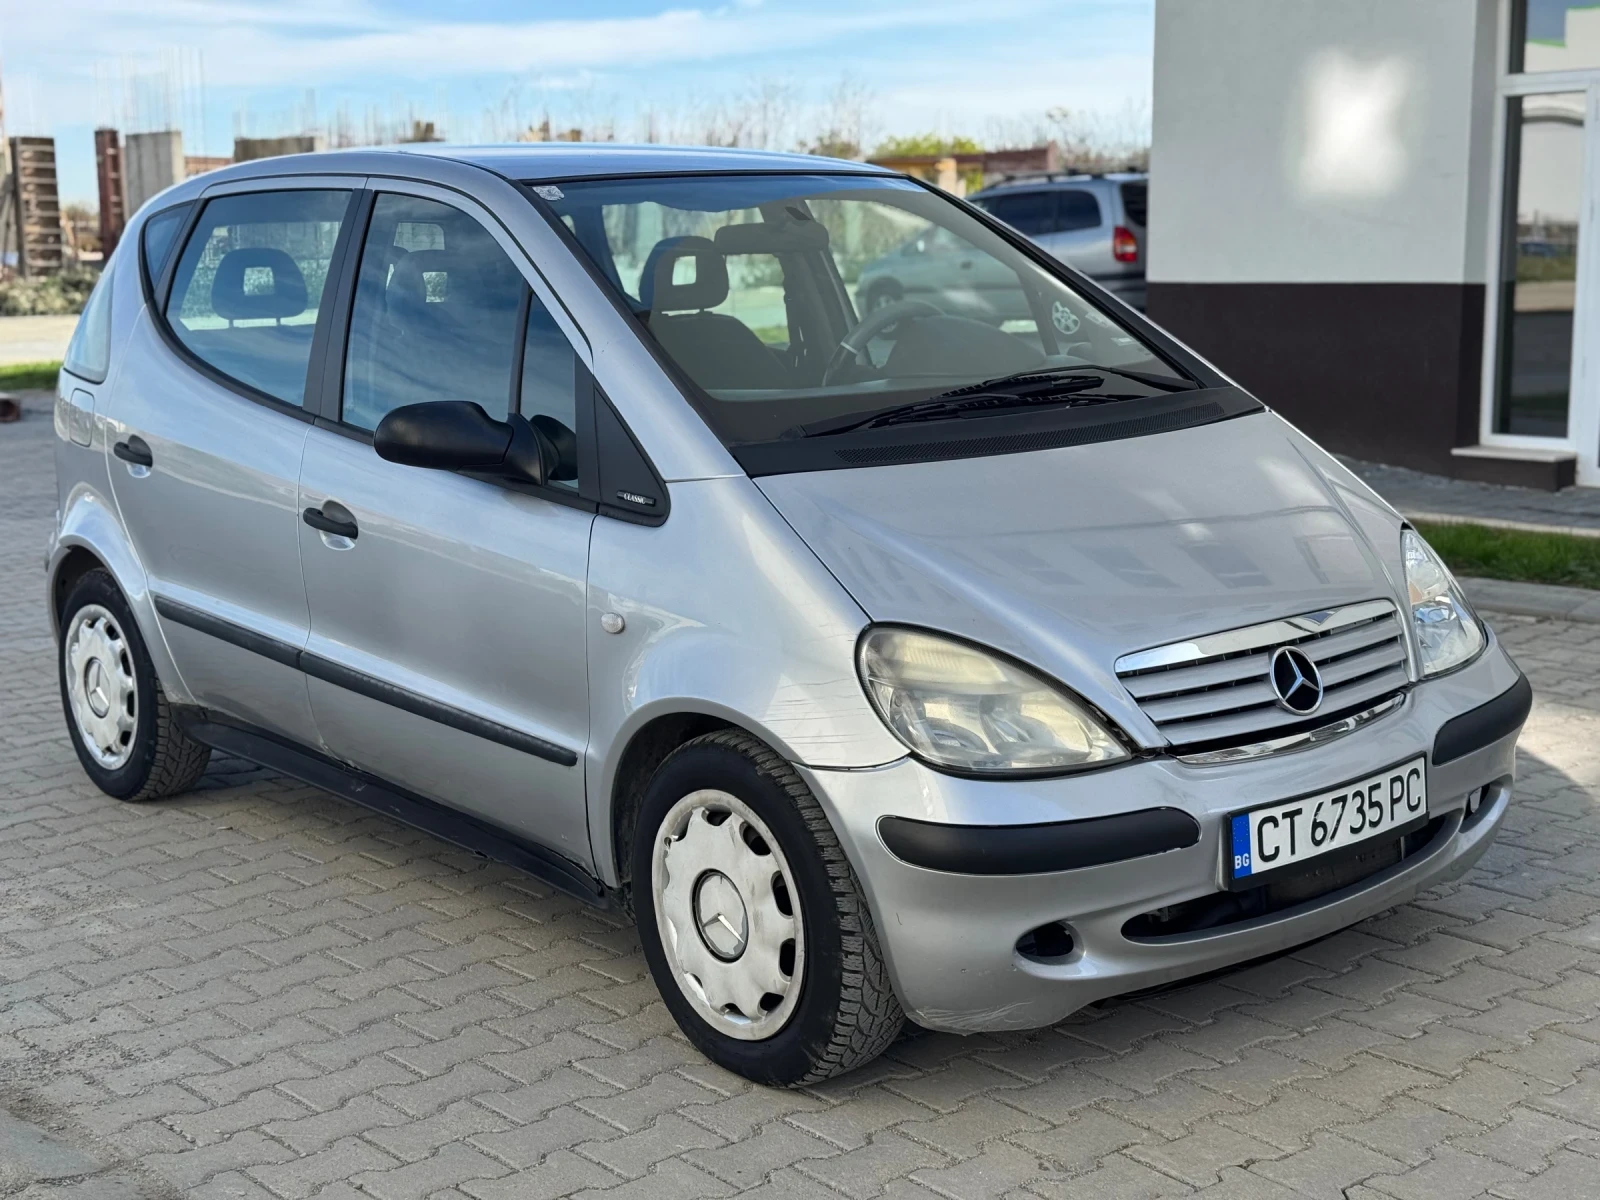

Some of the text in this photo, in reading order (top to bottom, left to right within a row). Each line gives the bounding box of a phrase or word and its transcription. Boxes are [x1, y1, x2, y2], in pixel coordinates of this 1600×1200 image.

[623, 492, 646, 505] CLASSIC
[1257, 768, 1421, 862] CT 6735 PC
[1234, 853, 1250, 870] BG
